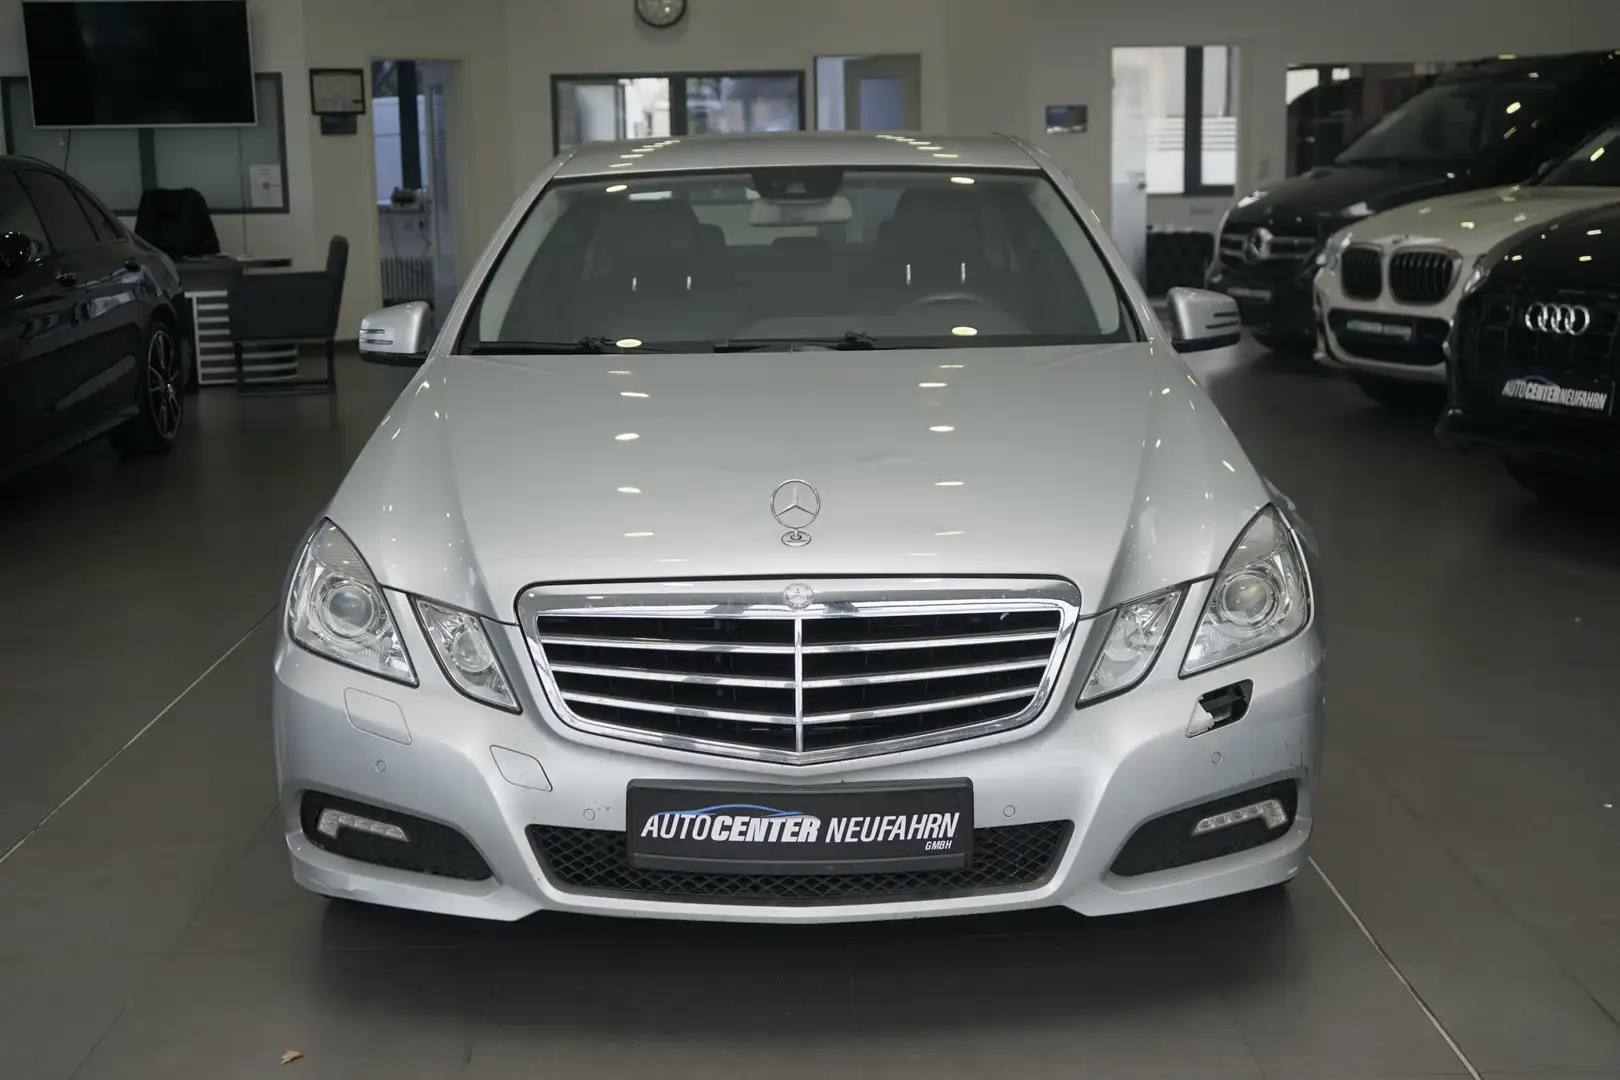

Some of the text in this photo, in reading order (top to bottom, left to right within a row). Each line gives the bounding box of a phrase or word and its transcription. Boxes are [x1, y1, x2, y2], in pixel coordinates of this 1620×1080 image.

[1502, 380, 1608, 411] AUTOCENTER NEUFAHRN
[640, 812, 960, 843] AUTOCENTER NEUFAHRN
[924, 841, 952, 851] GMBH
